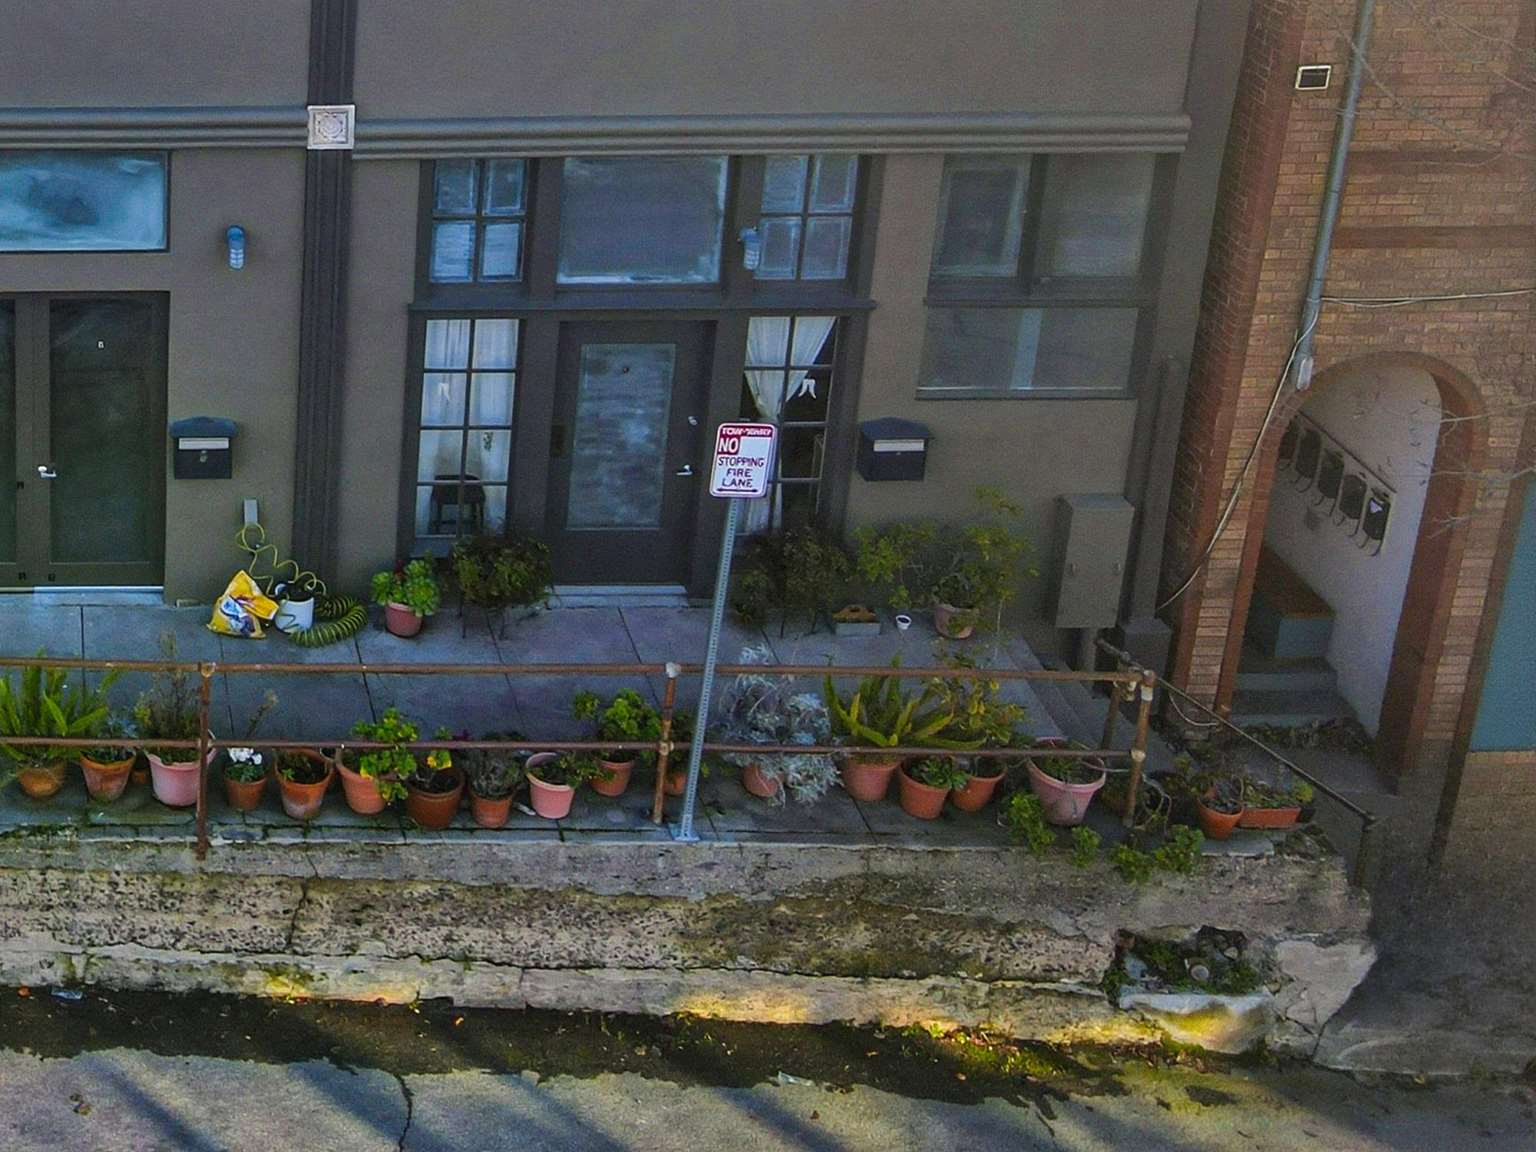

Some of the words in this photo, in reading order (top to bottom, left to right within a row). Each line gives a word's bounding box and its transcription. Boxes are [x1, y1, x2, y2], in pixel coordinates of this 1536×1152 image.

[718, 437, 739, 453] NO
[718, 456, 765, 467] STOPPING
[726, 468, 754, 477] FIRE
[722, 478, 754, 488] LANE
